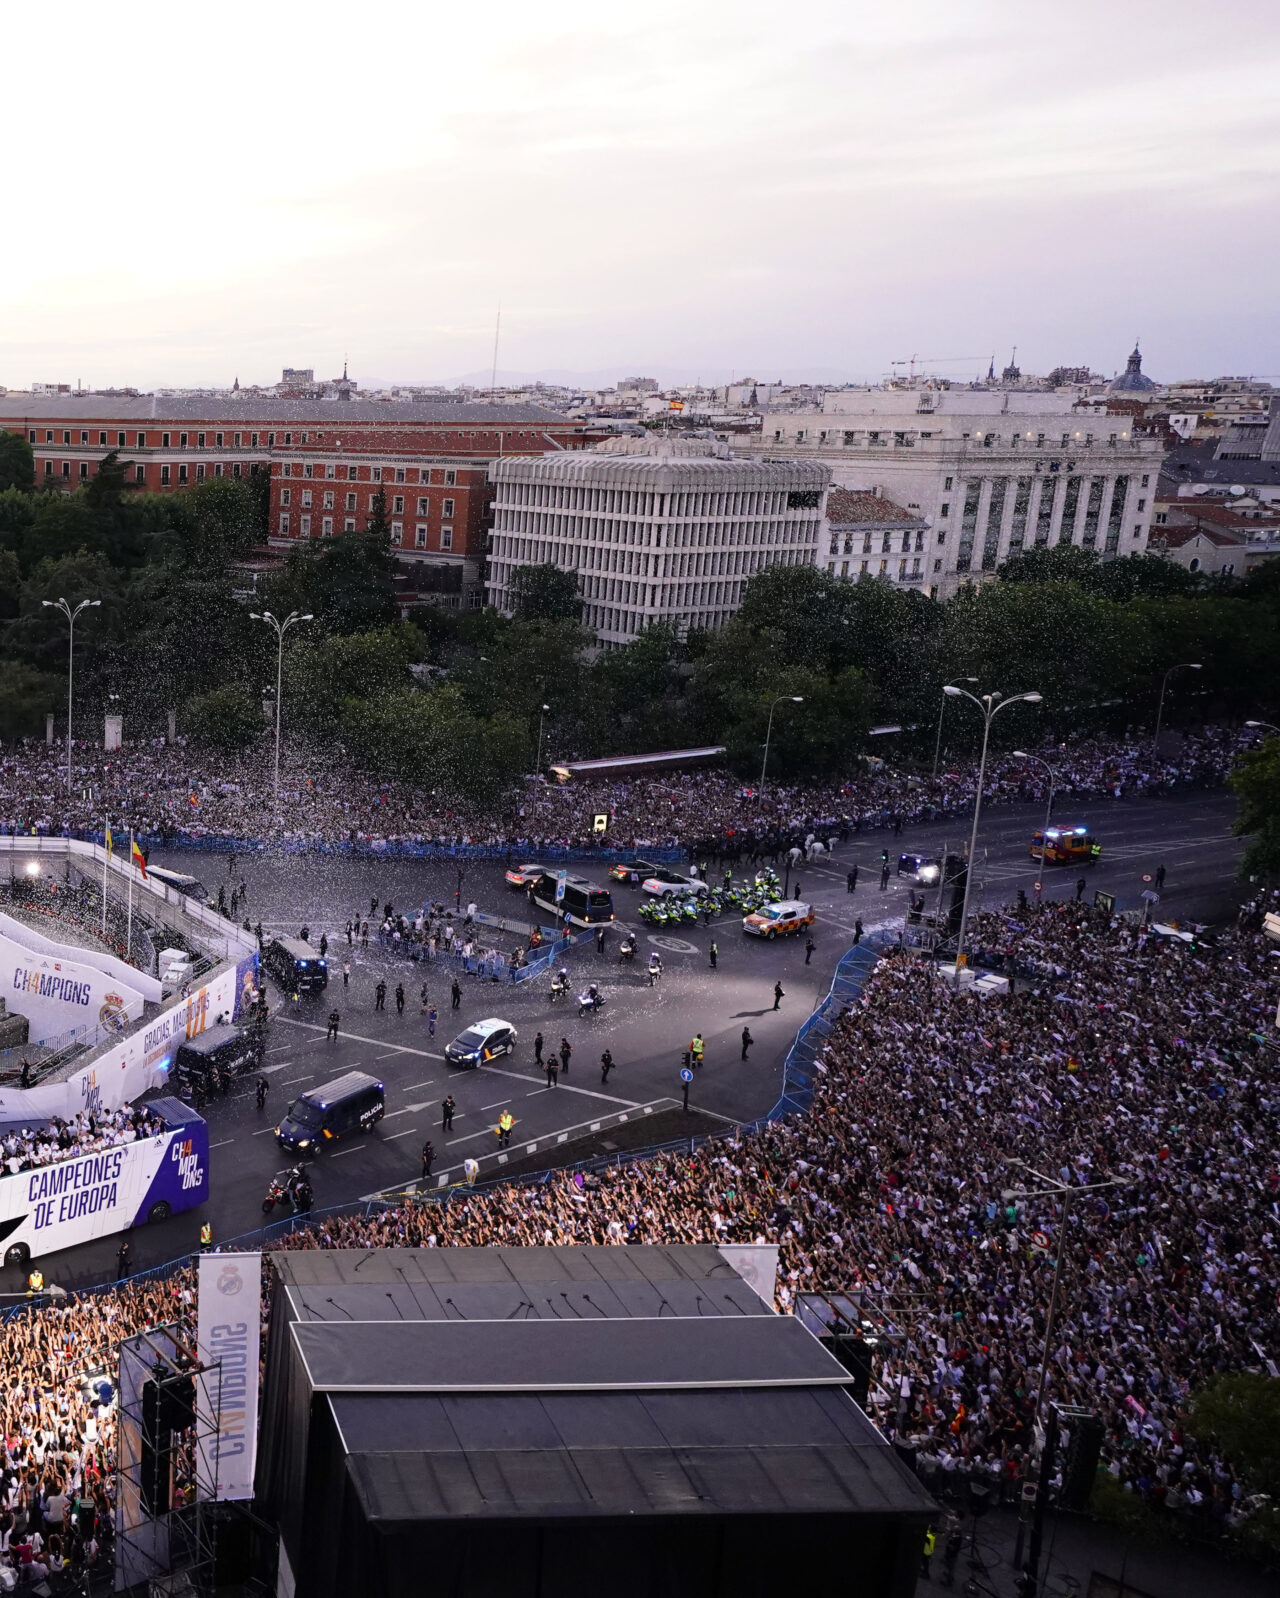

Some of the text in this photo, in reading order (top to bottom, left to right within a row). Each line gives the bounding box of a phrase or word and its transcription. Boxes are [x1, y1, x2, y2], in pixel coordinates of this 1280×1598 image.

[28, 1151, 123, 1203] CAMPEONES
[34, 1182, 118, 1231] DE EUROPA
